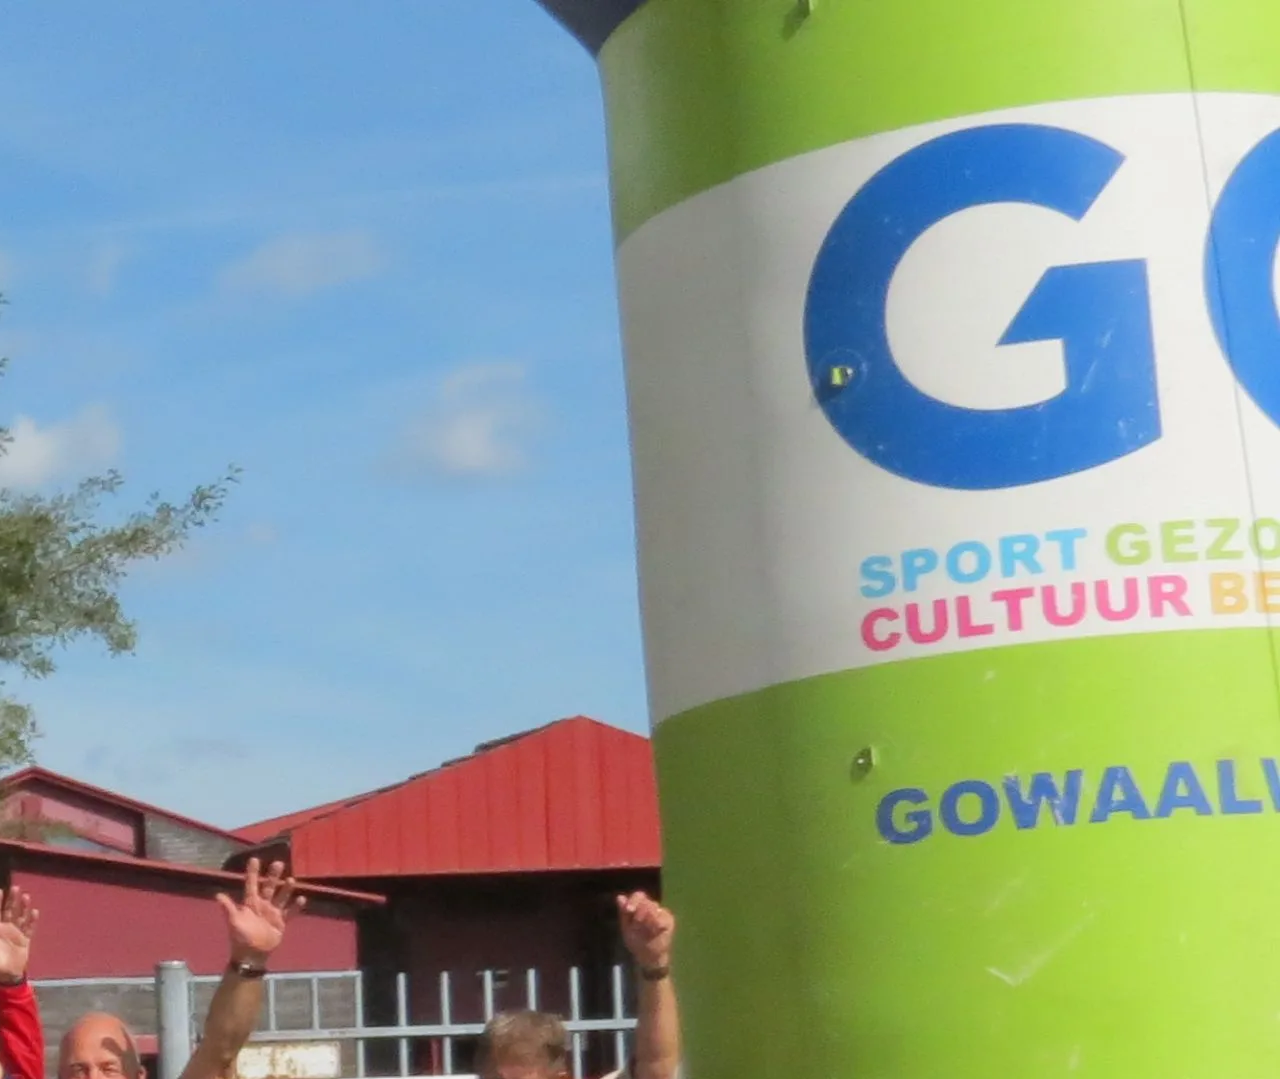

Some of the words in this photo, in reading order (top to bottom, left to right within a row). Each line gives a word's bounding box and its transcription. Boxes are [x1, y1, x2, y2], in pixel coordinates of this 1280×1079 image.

[803, 122, 1280, 492] G
[859, 527, 1087, 599] SPORT
[860, 575, 1194, 653] CULTUUR
[875, 758, 1280, 845] GOWAAL
